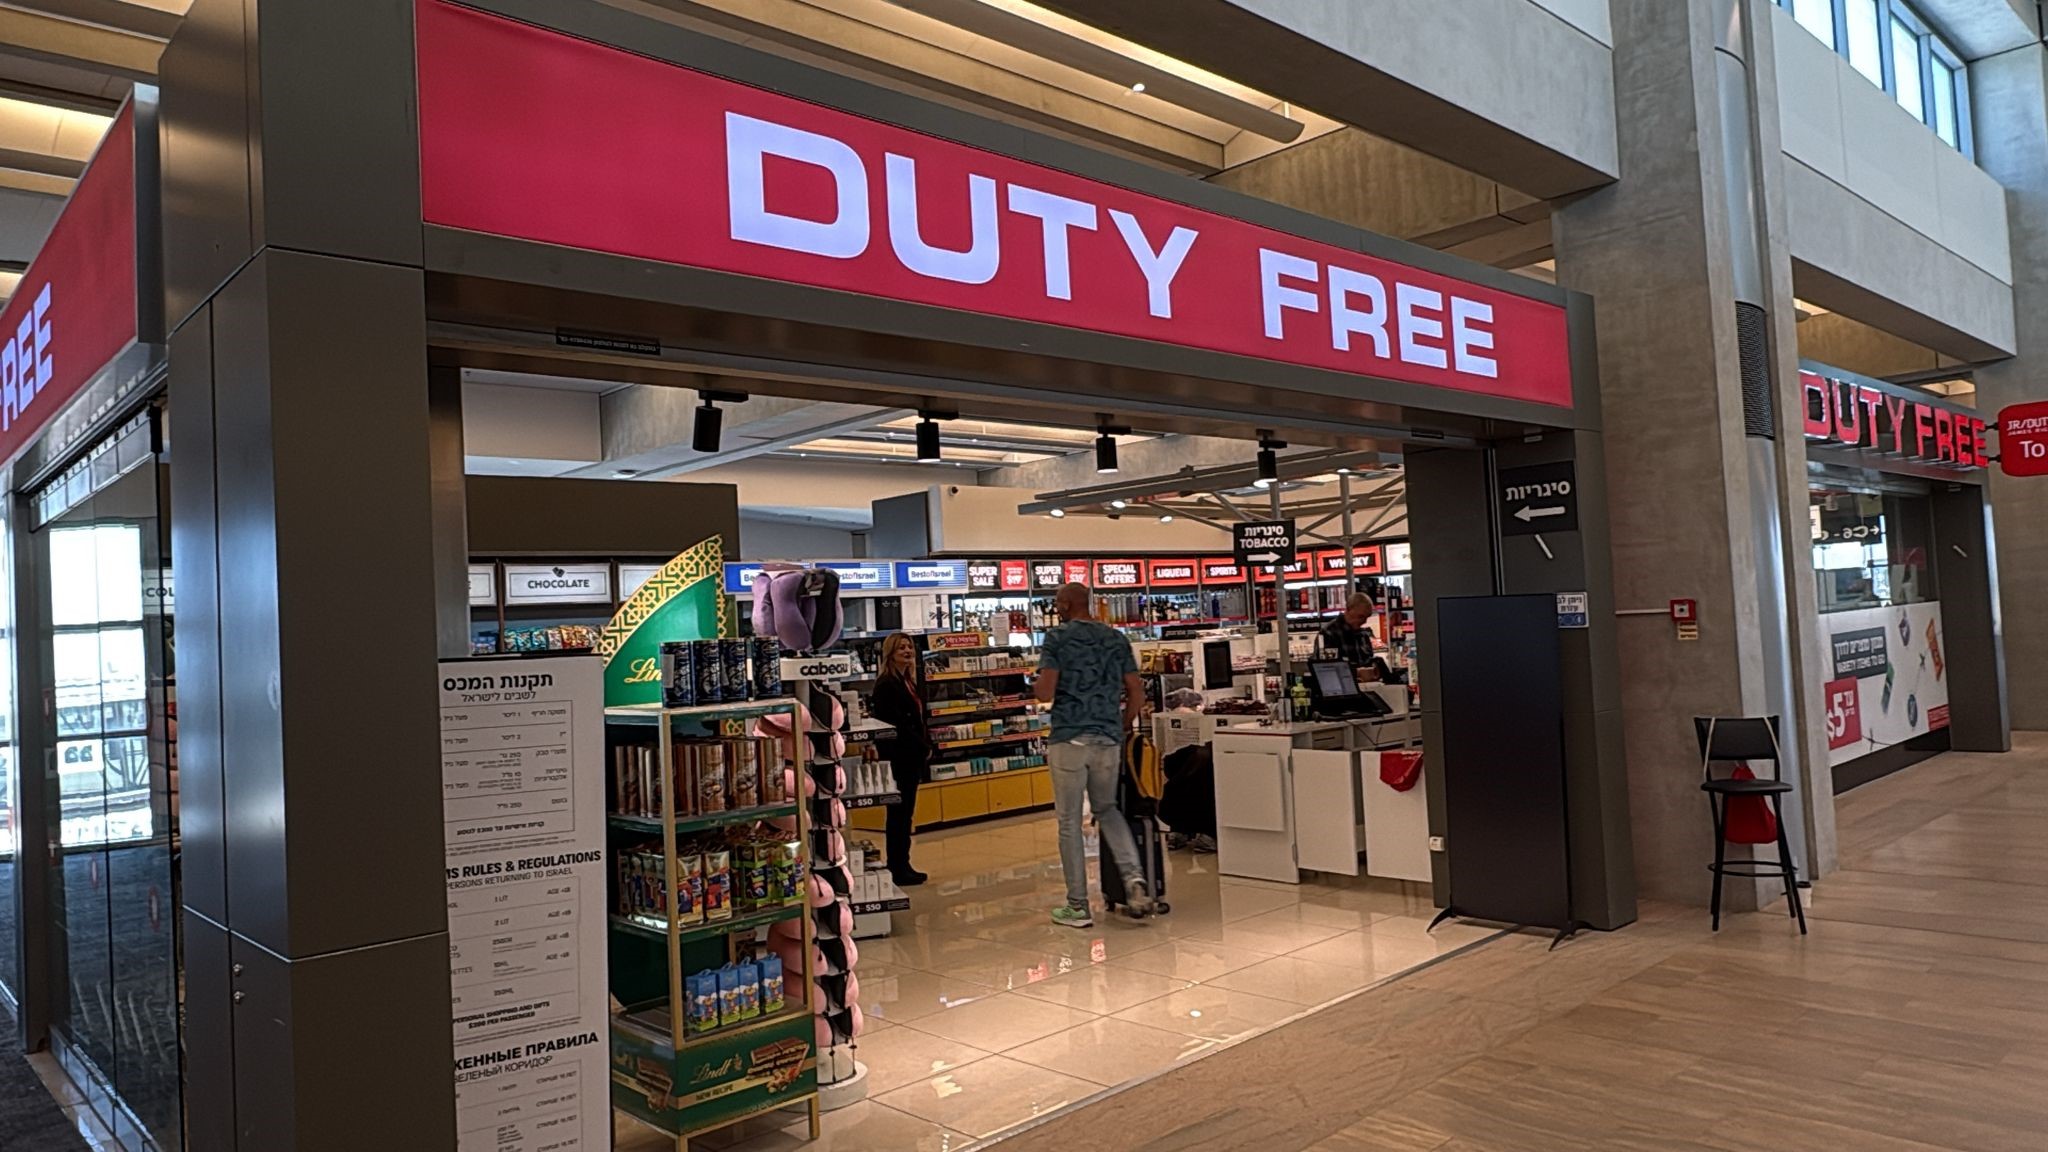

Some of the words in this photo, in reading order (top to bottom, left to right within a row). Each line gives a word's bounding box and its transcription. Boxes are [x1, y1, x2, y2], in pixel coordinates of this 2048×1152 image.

[724, 111, 1199, 319] DUTY
[1259, 247, 1498, 379] FREE
[0, 282, 52, 431] REE
[1798, 369, 1906, 453] DUTY
[1914, 403, 1990, 468] FREE
[2018, 440, 2046, 458] To
[1505, 481, 1571, 501] סיגריות
[1244, 525, 1284, 536] סיגריות
[1239, 537, 1290, 549] TOBACCO
[1265, 562, 1302, 573] WSKY
[1329, 556, 1370, 568] WHSKY
[969, 566, 998, 576] SUPER
[1035, 566, 1062, 576] SUPER
[1102, 564, 1136, 574] SPECIAL
[1156, 568, 1191, 578] LIQUEUR
[1210, 566, 1238, 576] SPIRITS
[527, 578, 590, 589] CHOCOLATE
[972, 576, 994, 586] SALE
[1039, 576, 1058, 585] SALE
[1104, 574, 1136, 584] OFFERS
[624, 658, 663, 684] Lin
[800, 661, 848, 676] cabeau
[443, 676, 494, 691] המכס
[500, 674, 553, 690] תקנות
[462, 692, 500, 702] לישראל
[504, 690, 536, 700] לשבים
[463, 862, 501, 878] RULES
[506, 861, 514, 872] &
[518, 850, 601, 871] REGULATIONS
[485, 872, 531, 884] RETURNING
[546, 867, 572, 876] ISRAEL
[526, 1032, 598, 1056] ПРАВИЛА
[504, 1056, 553, 1072] КОРИДОР
[690, 1056, 733, 1084] Lindt
